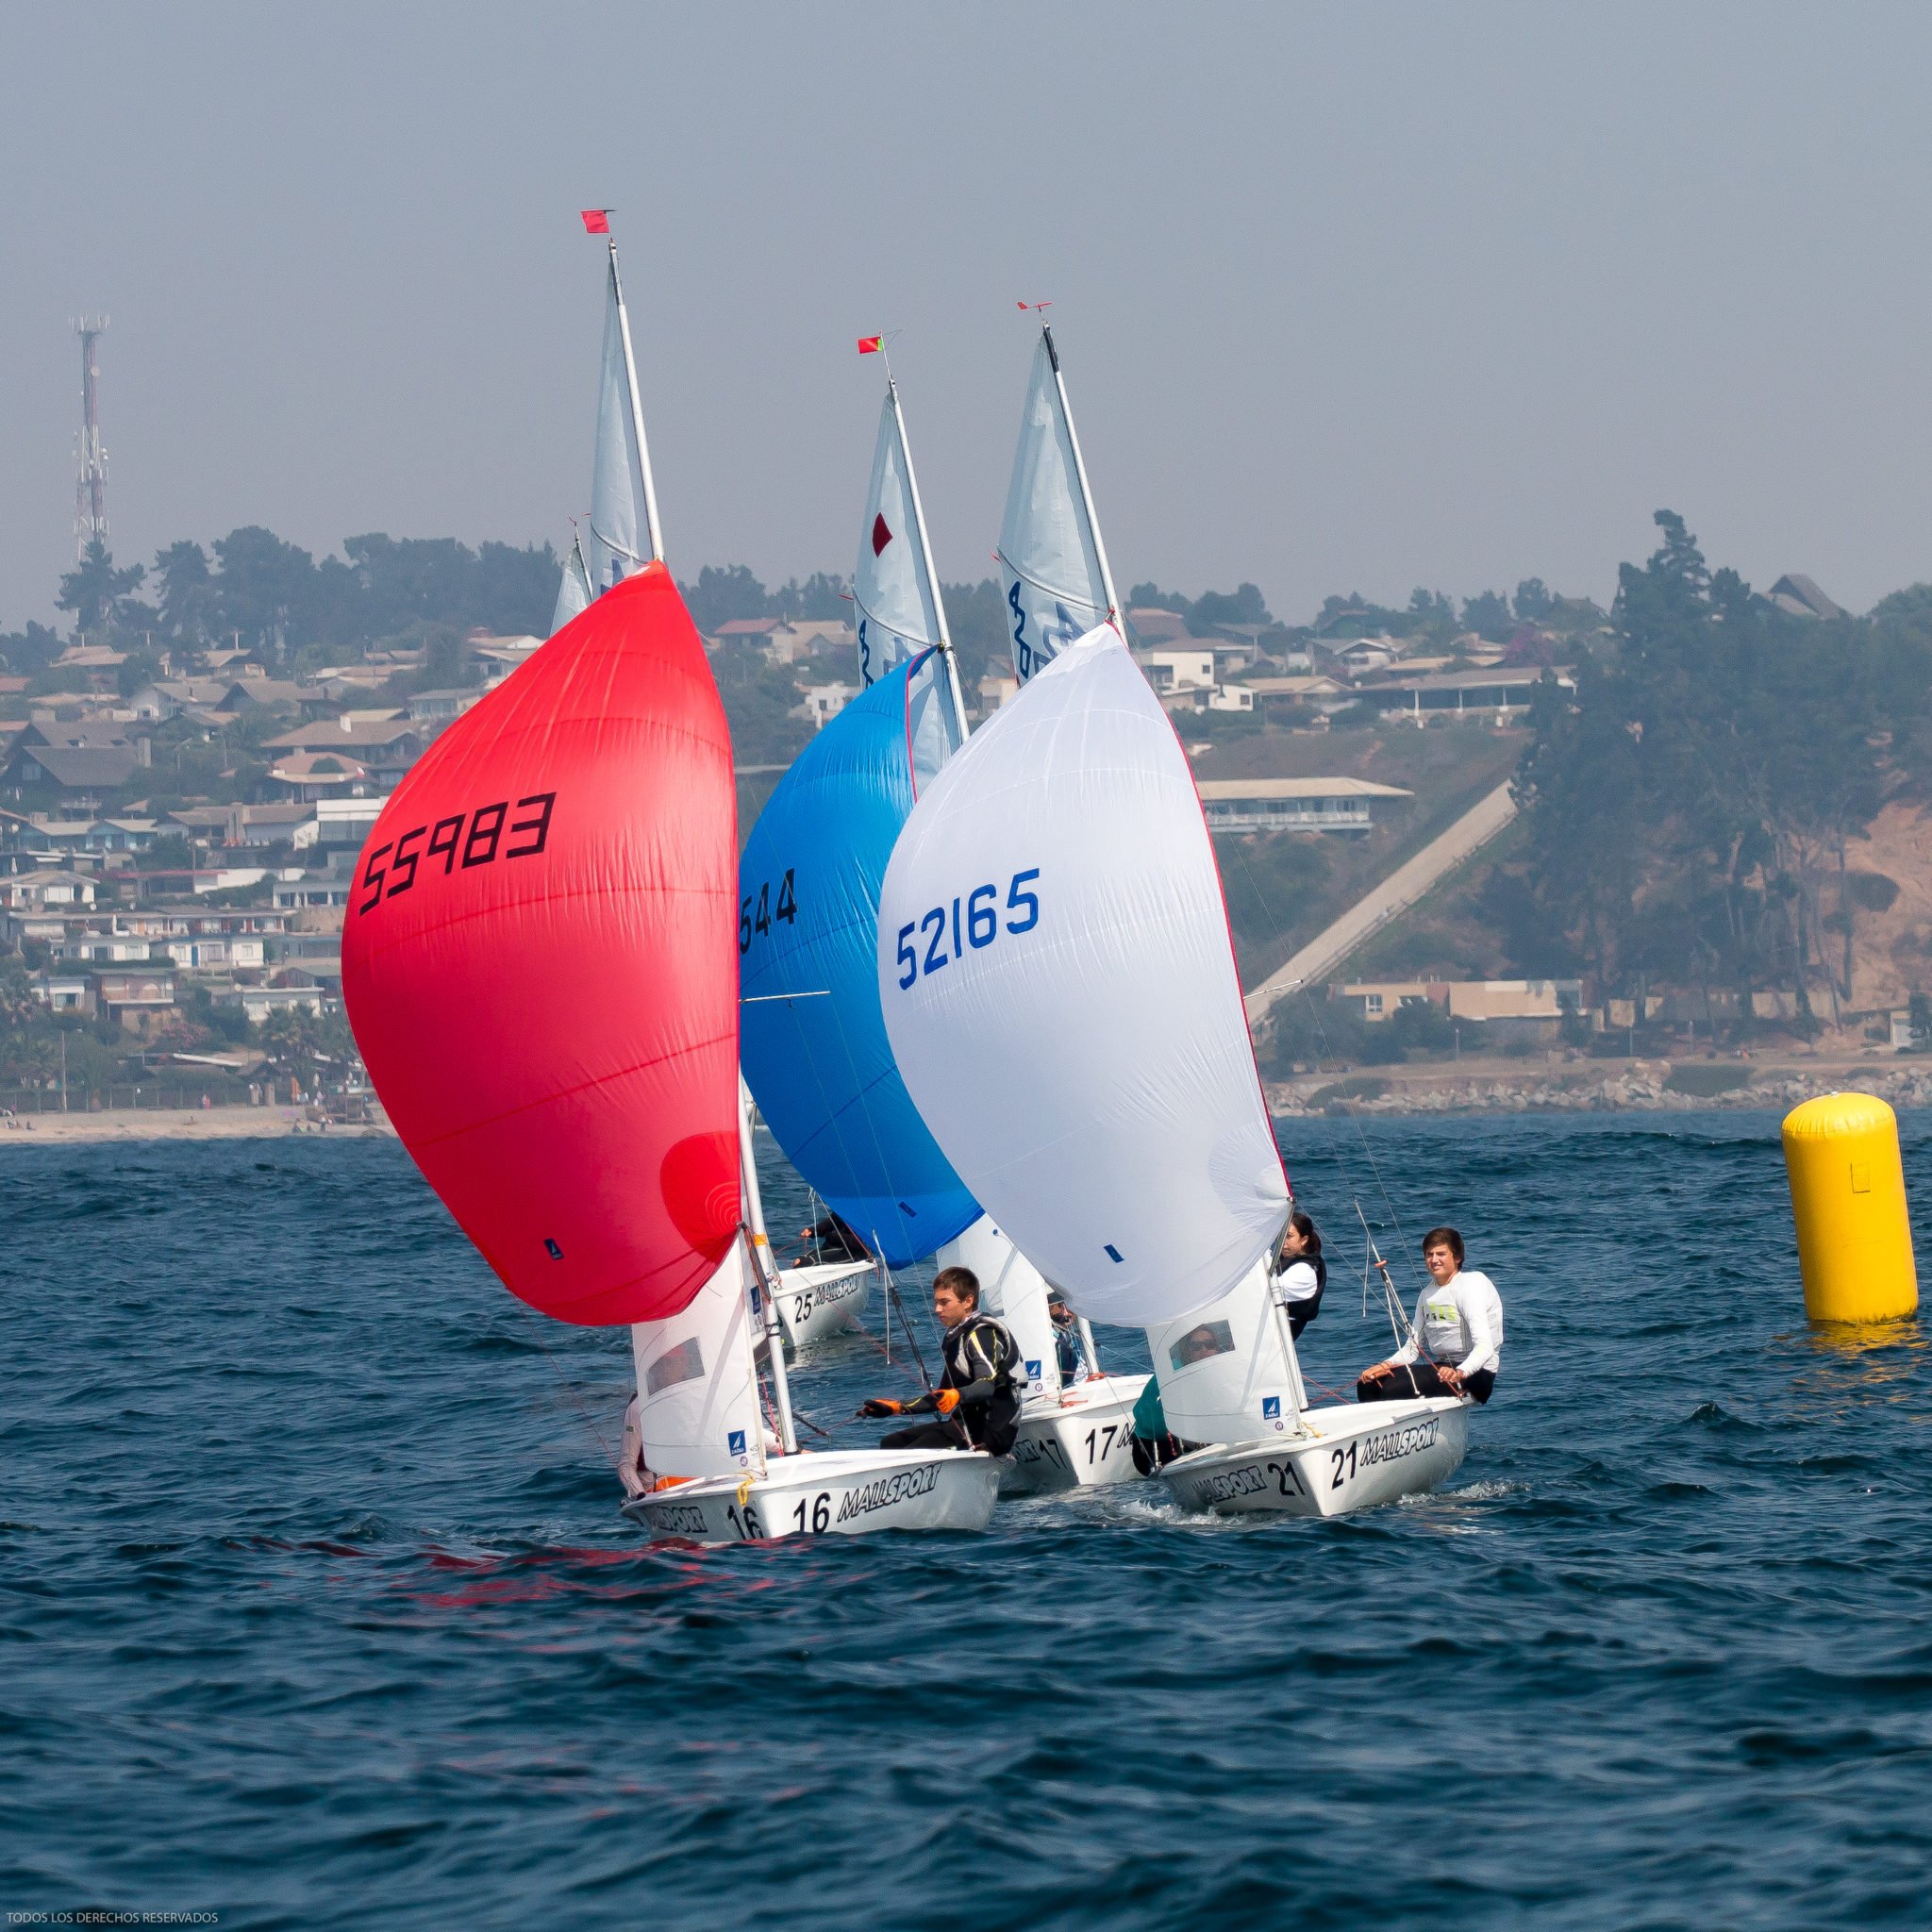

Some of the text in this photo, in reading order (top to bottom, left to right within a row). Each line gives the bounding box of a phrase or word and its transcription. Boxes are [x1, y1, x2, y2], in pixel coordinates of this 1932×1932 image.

[359, 791, 558, 918] 55983
[897, 867, 1041, 991] 52165
[794, 1292, 813, 1324] 25
[1039, 1438, 1068, 1470] 17
[1085, 1424, 1118, 1465] 17
[1331, 1417, 1440, 1491] 21 MALLSPORT
[793, 1463, 943, 1533] 16 MALLSPORT
[1267, 1460, 1306, 1496] 21
[727, 1504, 765, 1541] 16
